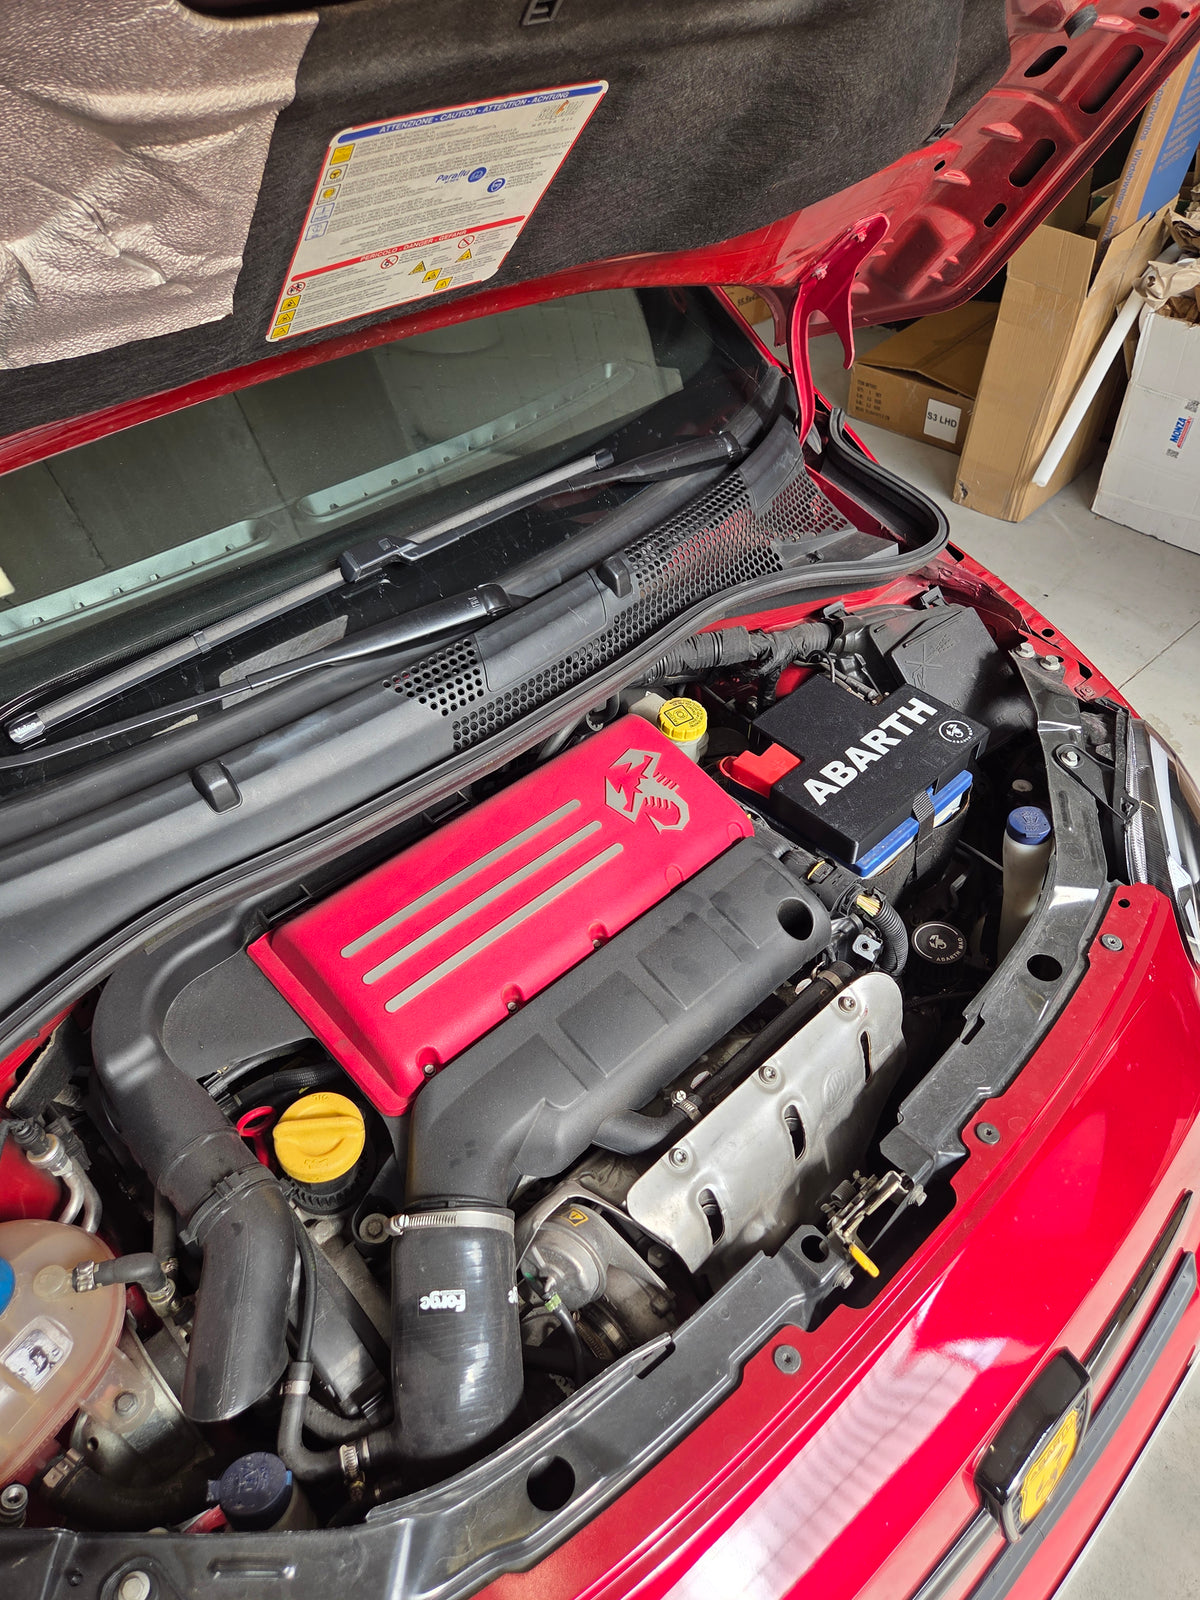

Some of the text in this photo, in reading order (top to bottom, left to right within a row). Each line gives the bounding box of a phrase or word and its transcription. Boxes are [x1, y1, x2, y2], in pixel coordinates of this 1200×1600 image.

[379, 91, 569, 134] ATTENZIONE CAUTION ATTENTION ACHTUNG
[1114, 148, 1143, 211] Windabweiser
[360, 246, 398, 262] PERICOLO
[403, 236, 434, 250] DANGER
[438, 229, 467, 242] GEFAHR
[927, 411, 958, 428] S3 LHD
[1169, 417, 1187, 443] MONZA
[803, 697, 938, 806] ABARTH
